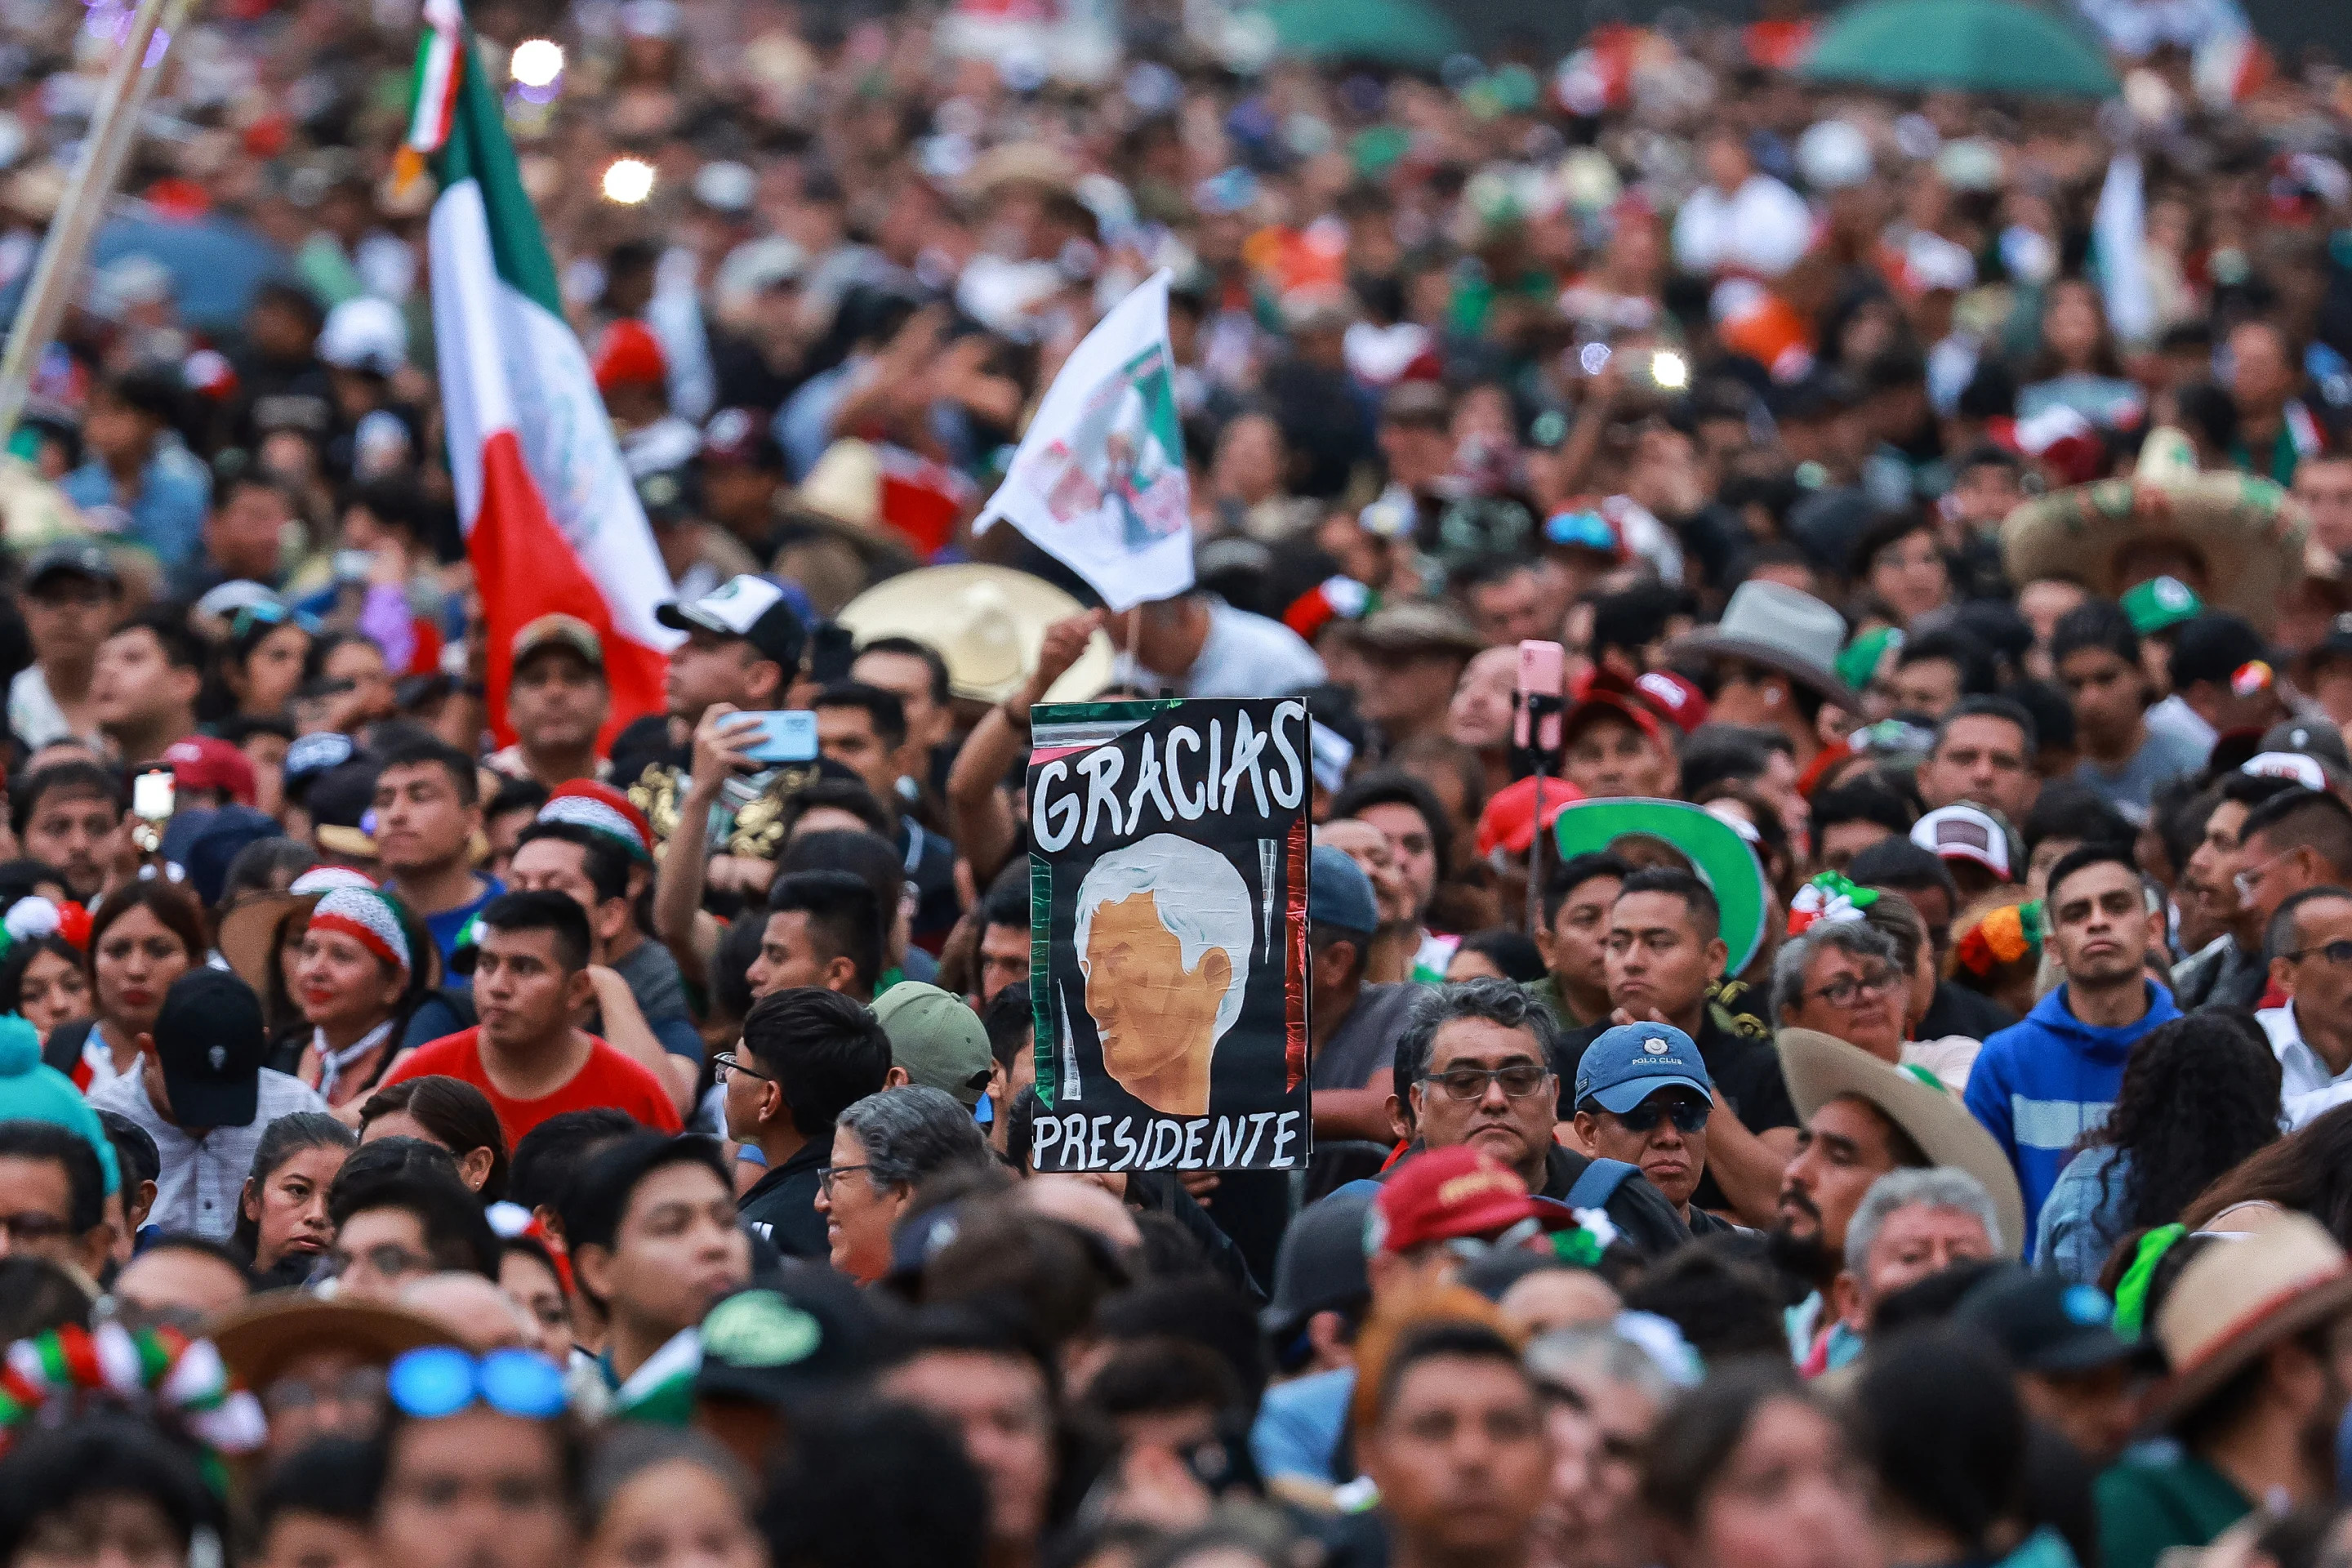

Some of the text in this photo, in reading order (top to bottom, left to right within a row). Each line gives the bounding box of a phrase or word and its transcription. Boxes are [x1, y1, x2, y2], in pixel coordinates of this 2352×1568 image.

[1033, 701, 1304, 852] GRACIAS
[1632, 1057, 1682, 1066] POLO CLUB
[1032, 1111, 1301, 1171] PRESIDENTE
